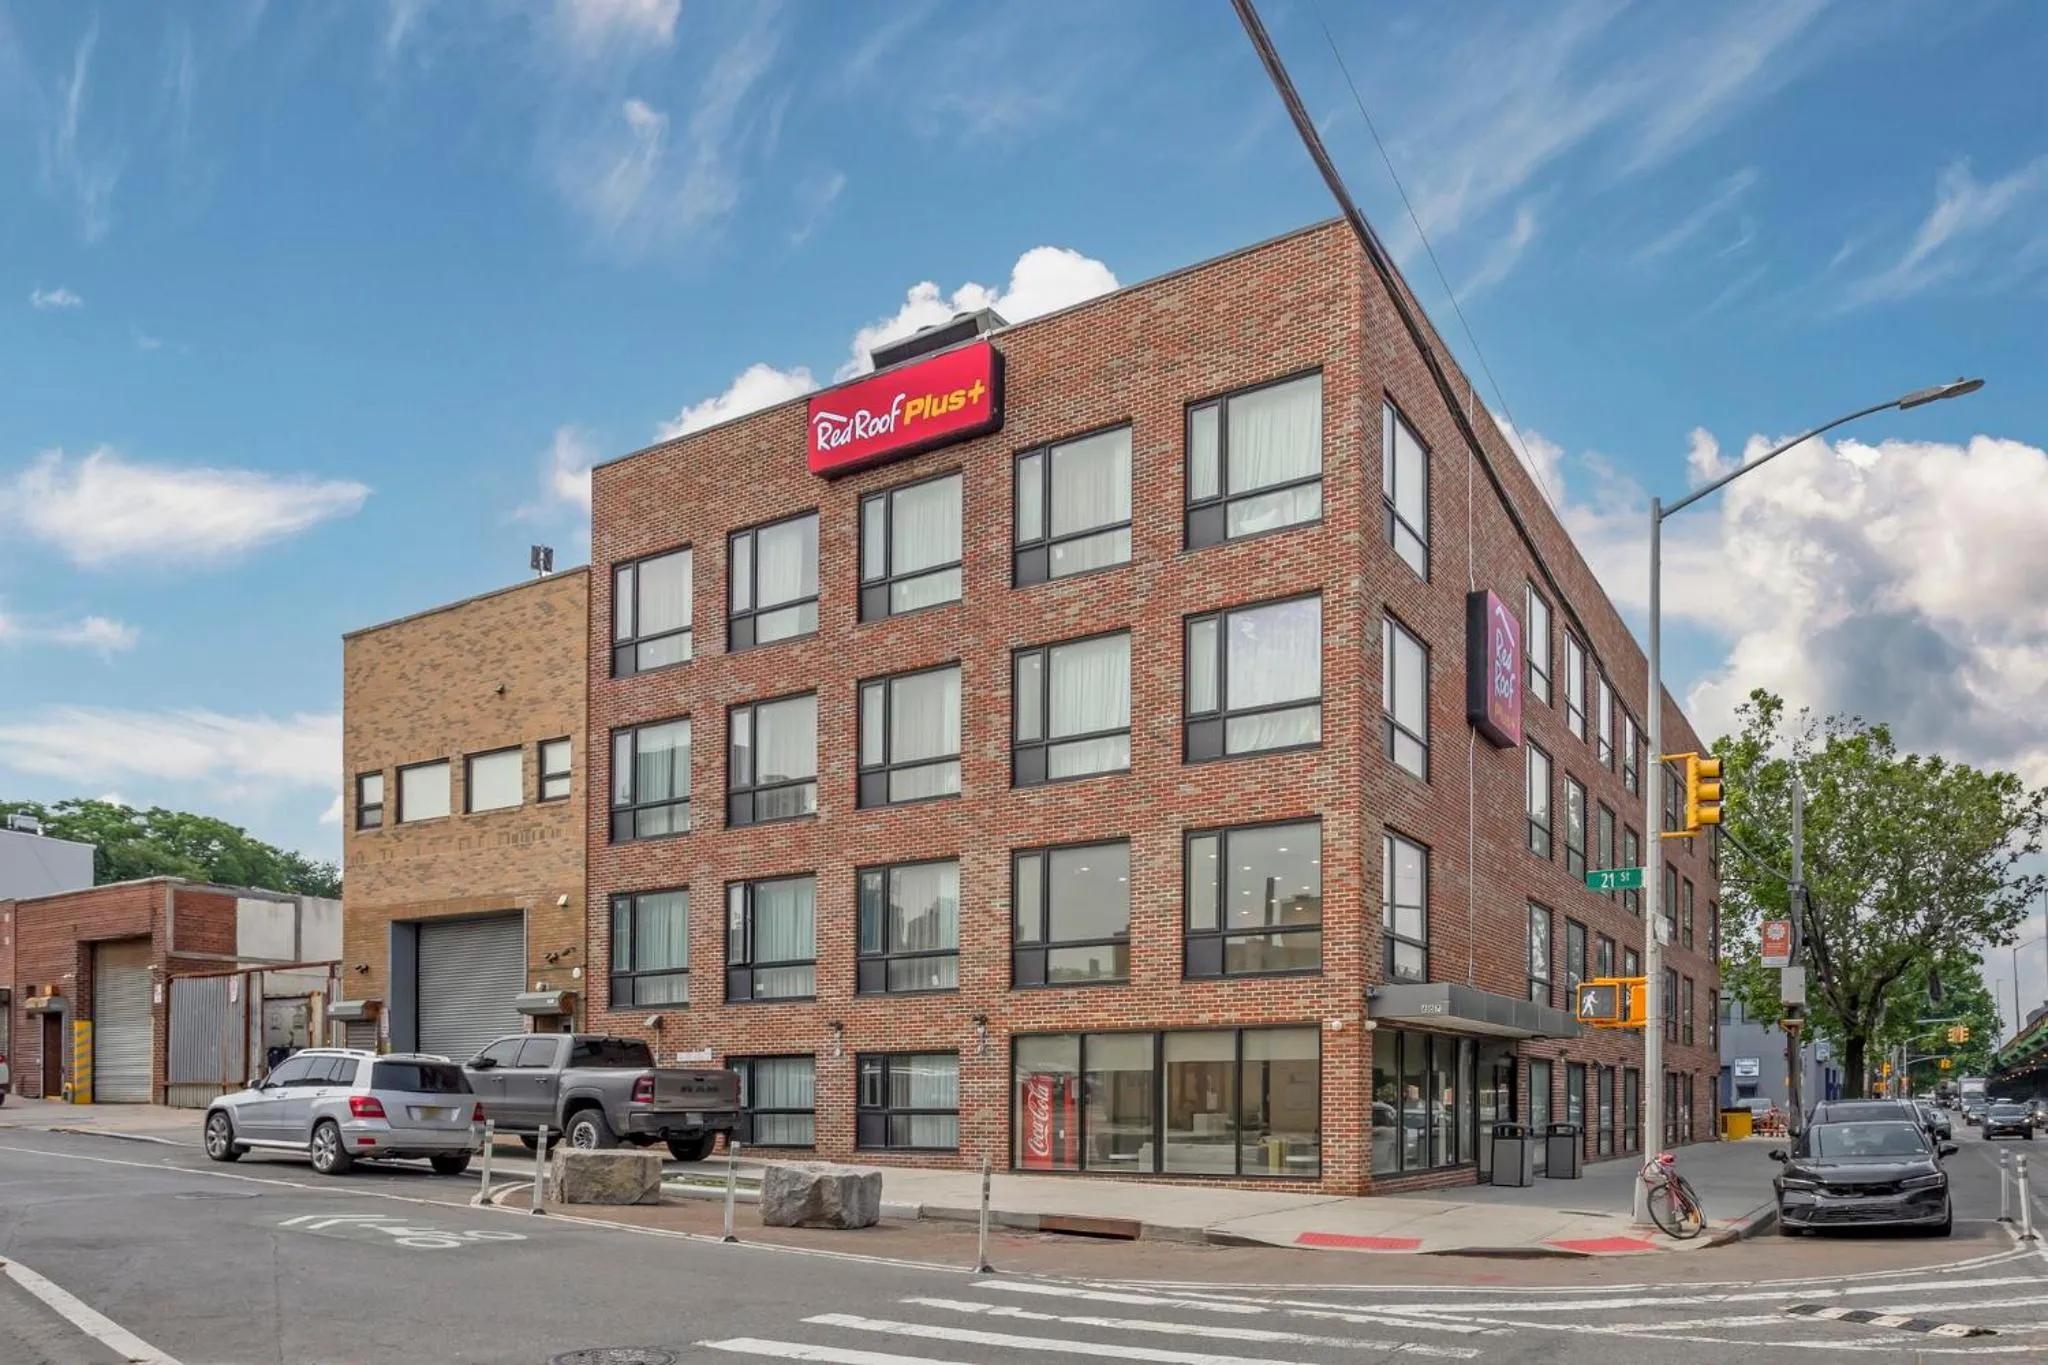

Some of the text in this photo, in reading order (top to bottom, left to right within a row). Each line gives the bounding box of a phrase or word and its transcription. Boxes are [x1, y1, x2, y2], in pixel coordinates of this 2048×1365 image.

[817, 380, 985, 451] Red Roof Plus+
[1496, 628, 1513, 670] Red
[1494, 660, 1516, 708] Roof
[1601, 872, 1615, 888] 21
